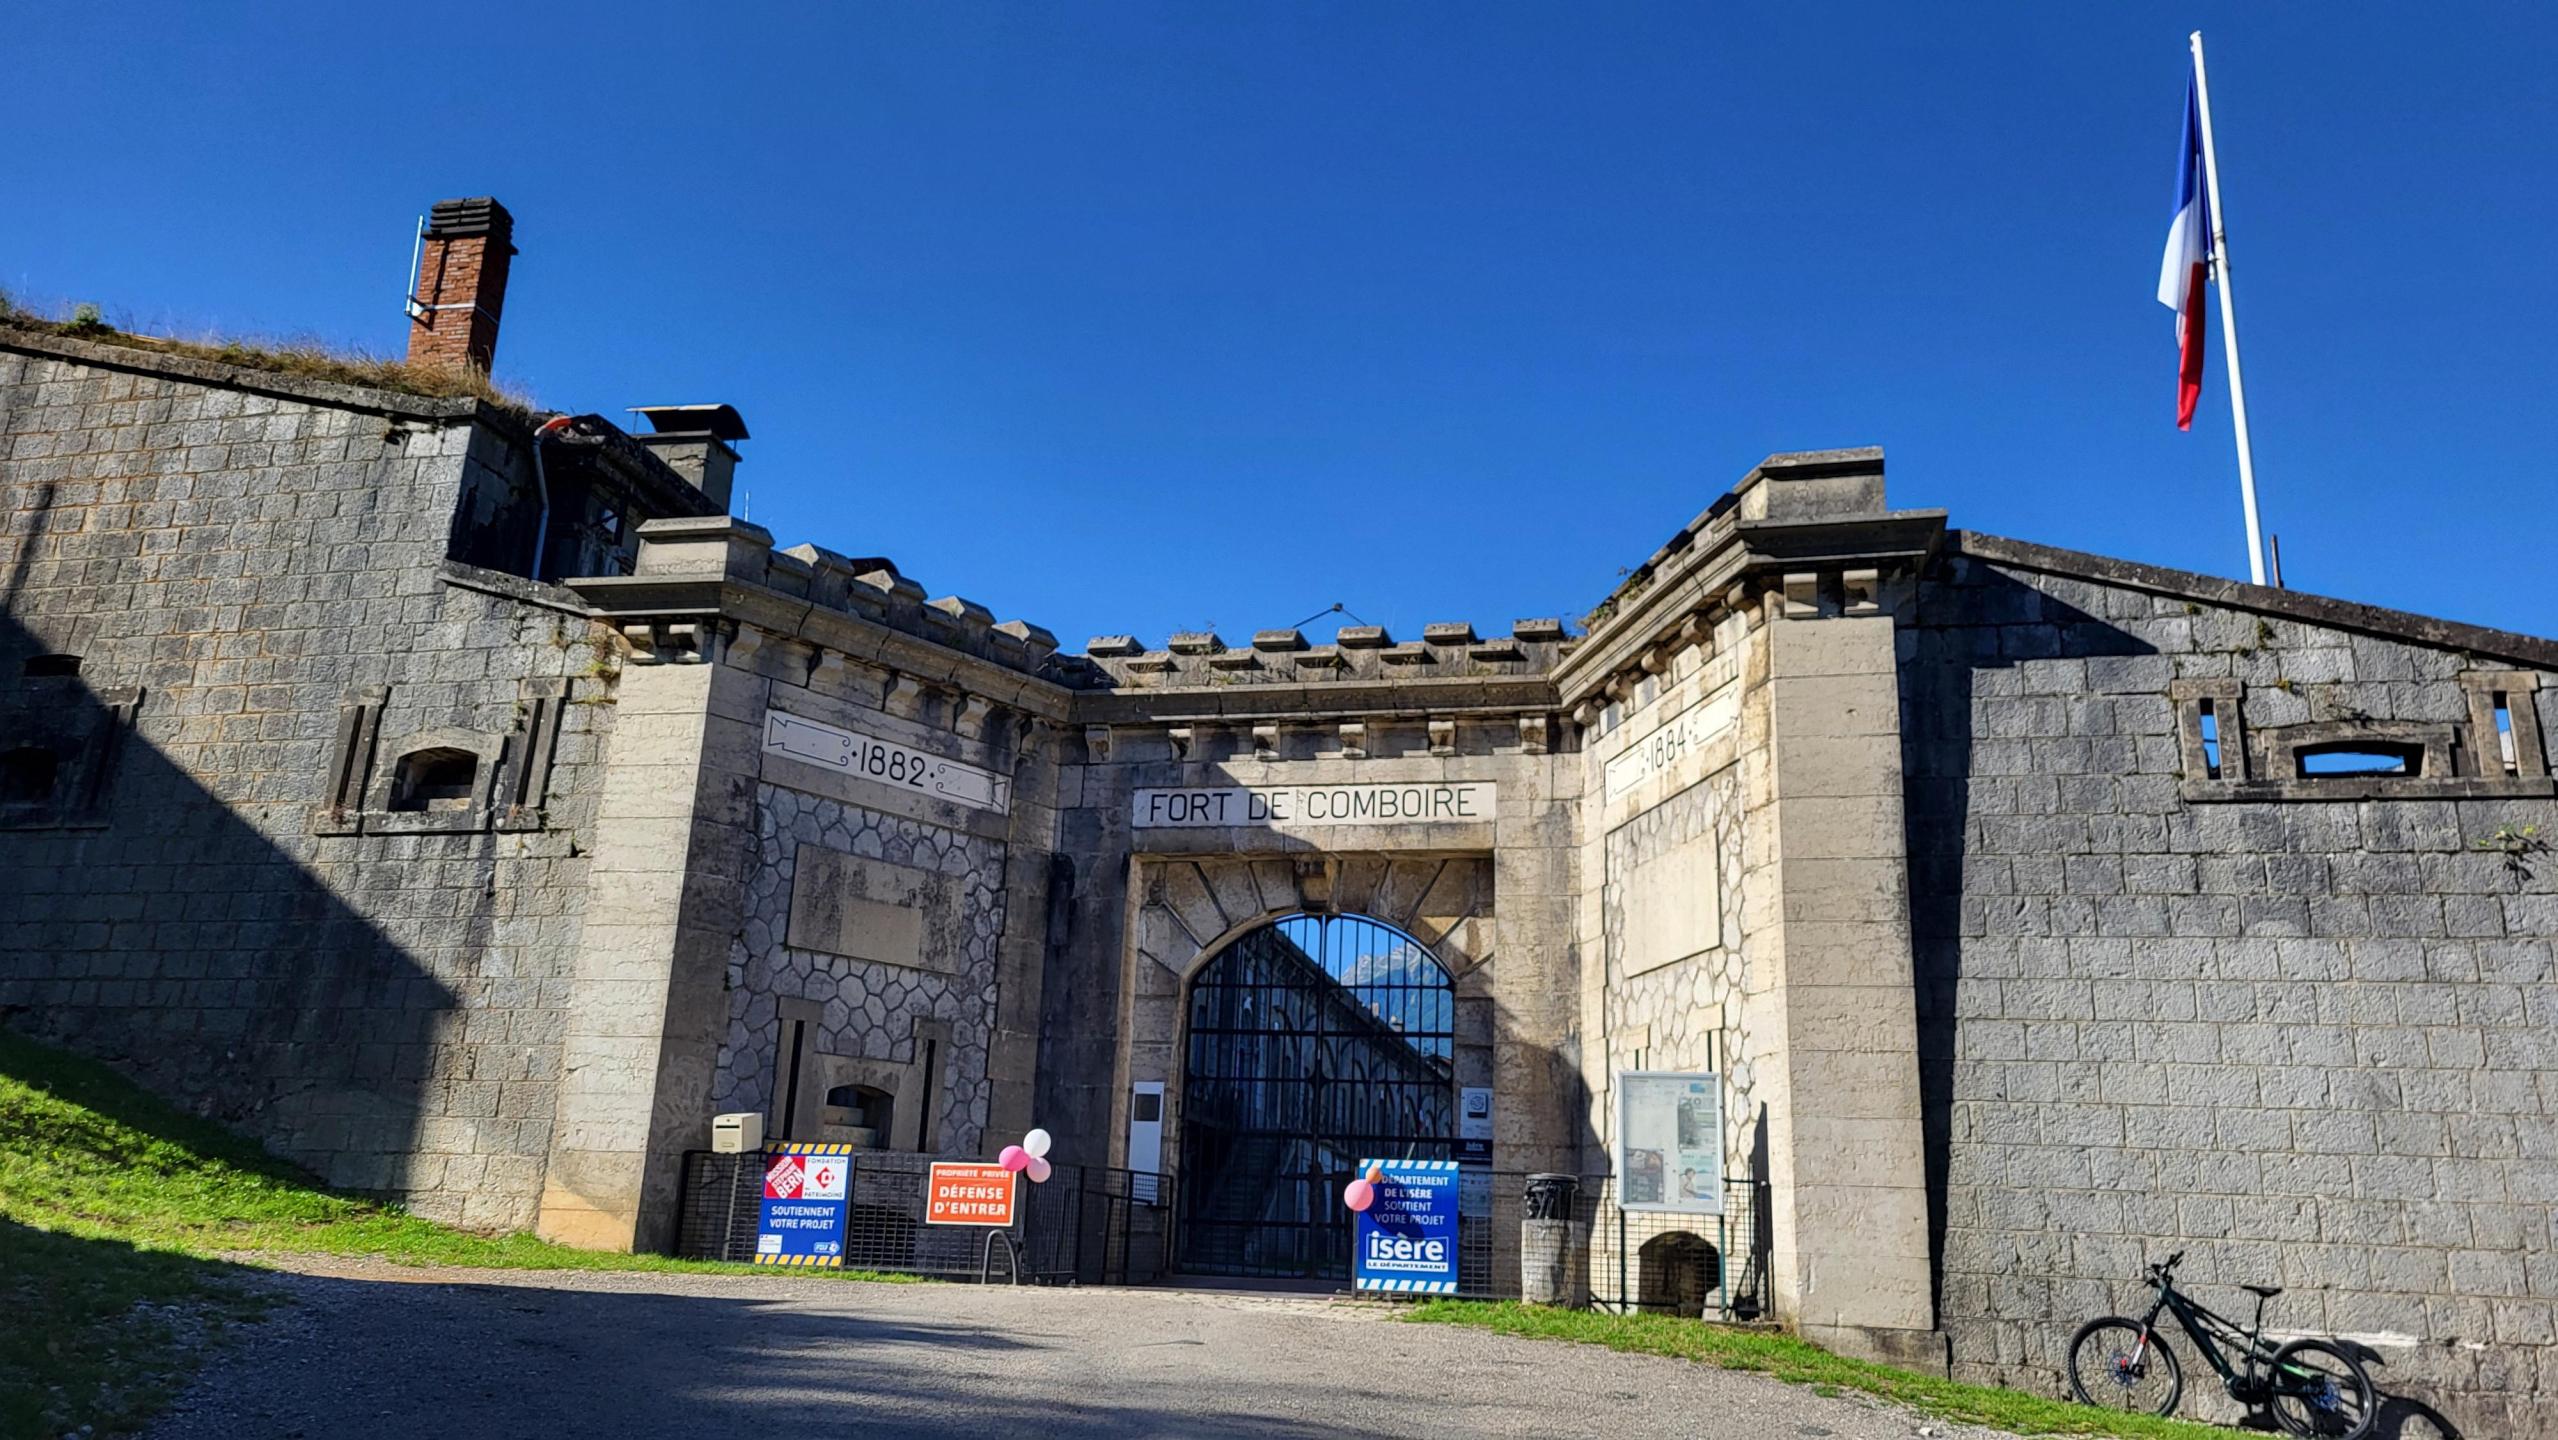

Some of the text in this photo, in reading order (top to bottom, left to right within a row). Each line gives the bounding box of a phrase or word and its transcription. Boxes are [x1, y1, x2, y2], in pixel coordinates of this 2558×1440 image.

[1650, 721, 1686, 773] 1884
[861, 741, 925, 787] 1882
[1149, 787, 1477, 822] FORT DE COMBOIRE
[777, 1168, 805, 1199] BERN
[1382, 1173, 1449, 1186] DÉPARTEMENT
[939, 1184, 1004, 1199] DÉFENSE
[1384, 1187, 1432, 1199] DE L'ISÈRE
[771, 1205, 835, 1217] SOUTIENNENT
[934, 1202, 1007, 1216] D'ENTRER
[1384, 1201, 1432, 1212] SOUTIENT
[769, 1218, 835, 1230] VOTRE PROJET
[1374, 1213, 1445, 1226] VOTRE PROJET
[1371, 1230, 1444, 1261] isère
